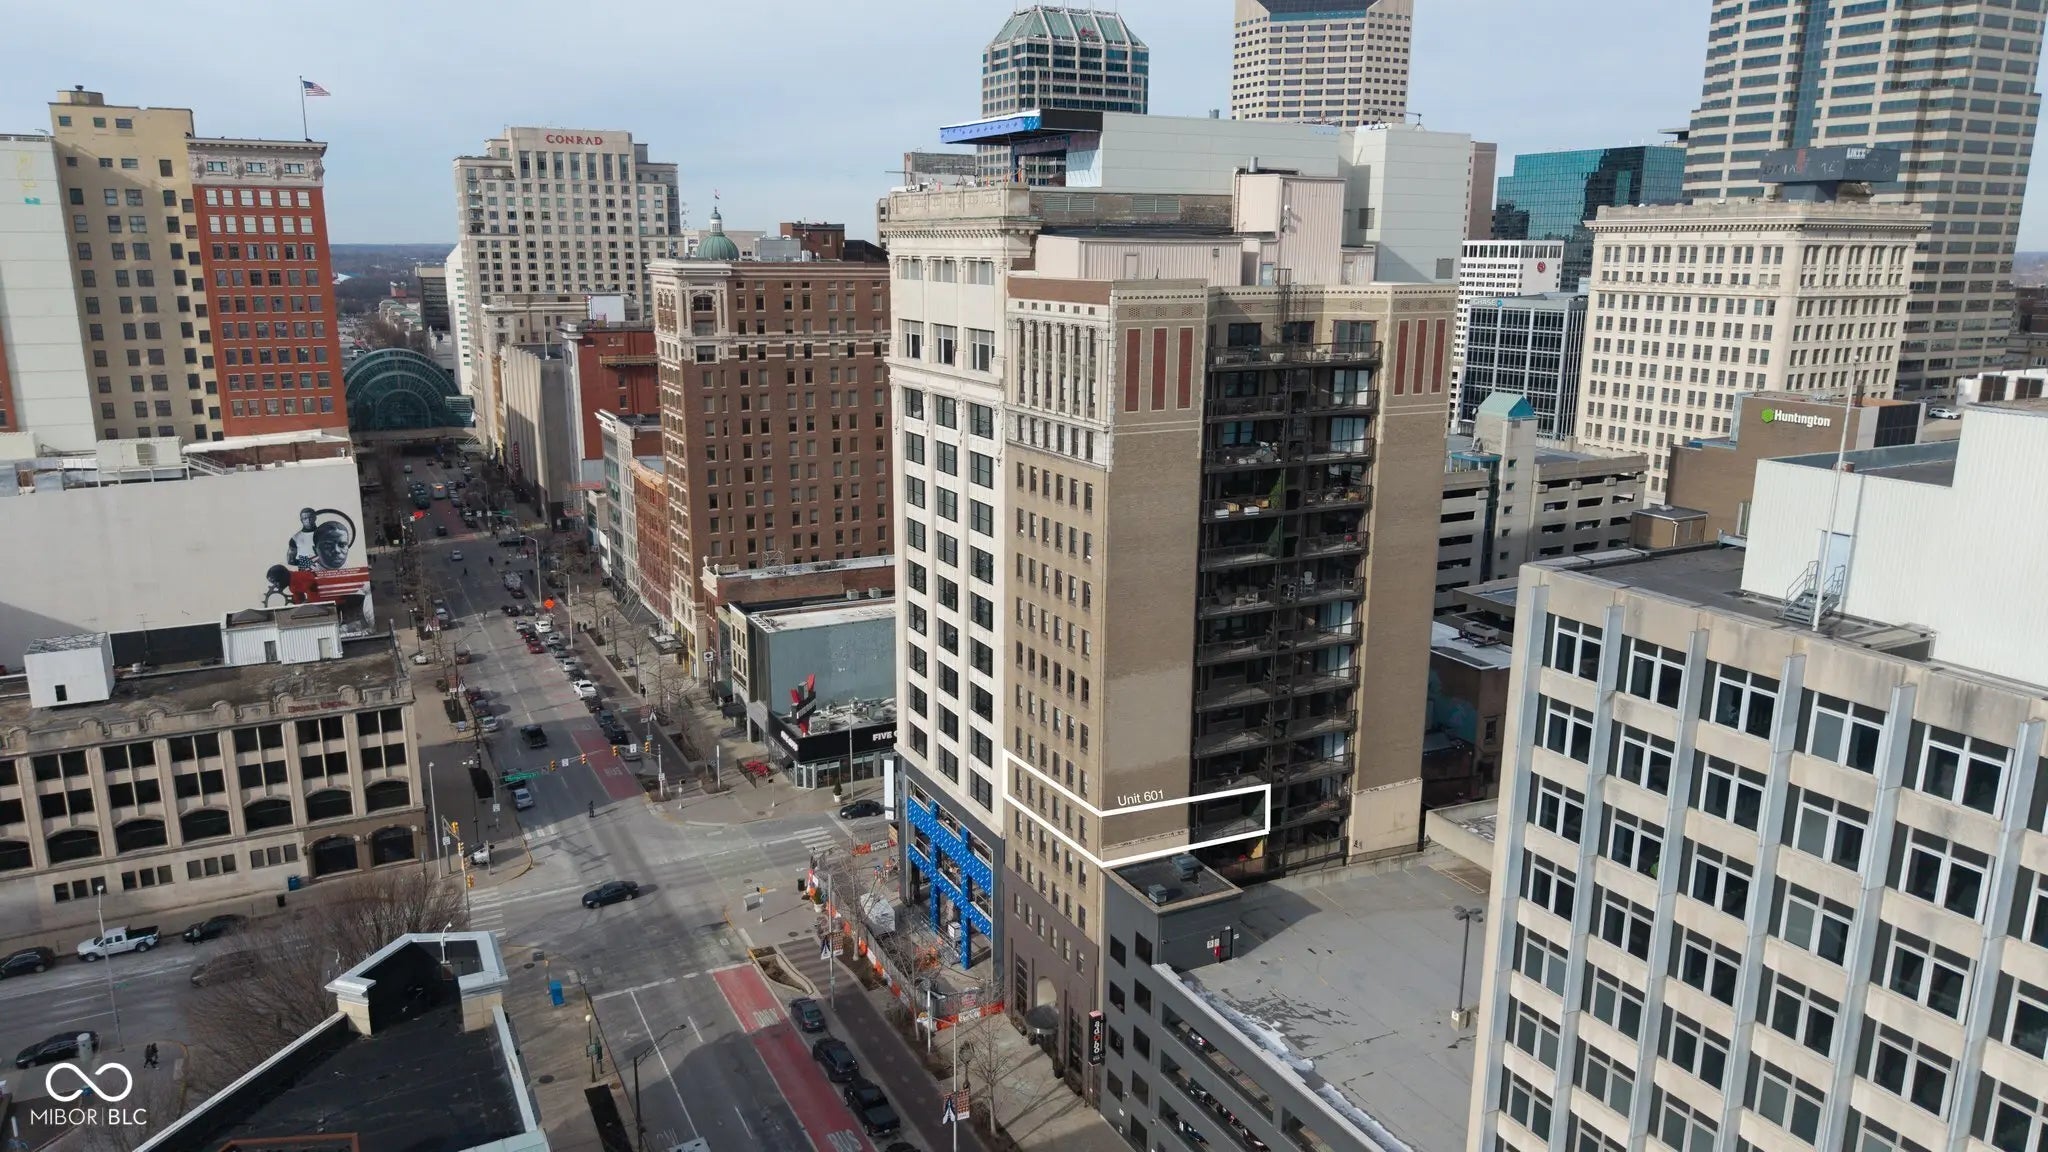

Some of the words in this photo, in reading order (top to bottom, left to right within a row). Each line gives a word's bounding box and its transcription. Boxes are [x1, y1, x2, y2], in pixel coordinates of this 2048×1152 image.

[546, 134, 603, 145] CONRAD
[1774, 409, 1831, 428] Huntington
[872, 731, 893, 741] FIVE
[826, 1128, 863, 1152] BUS
